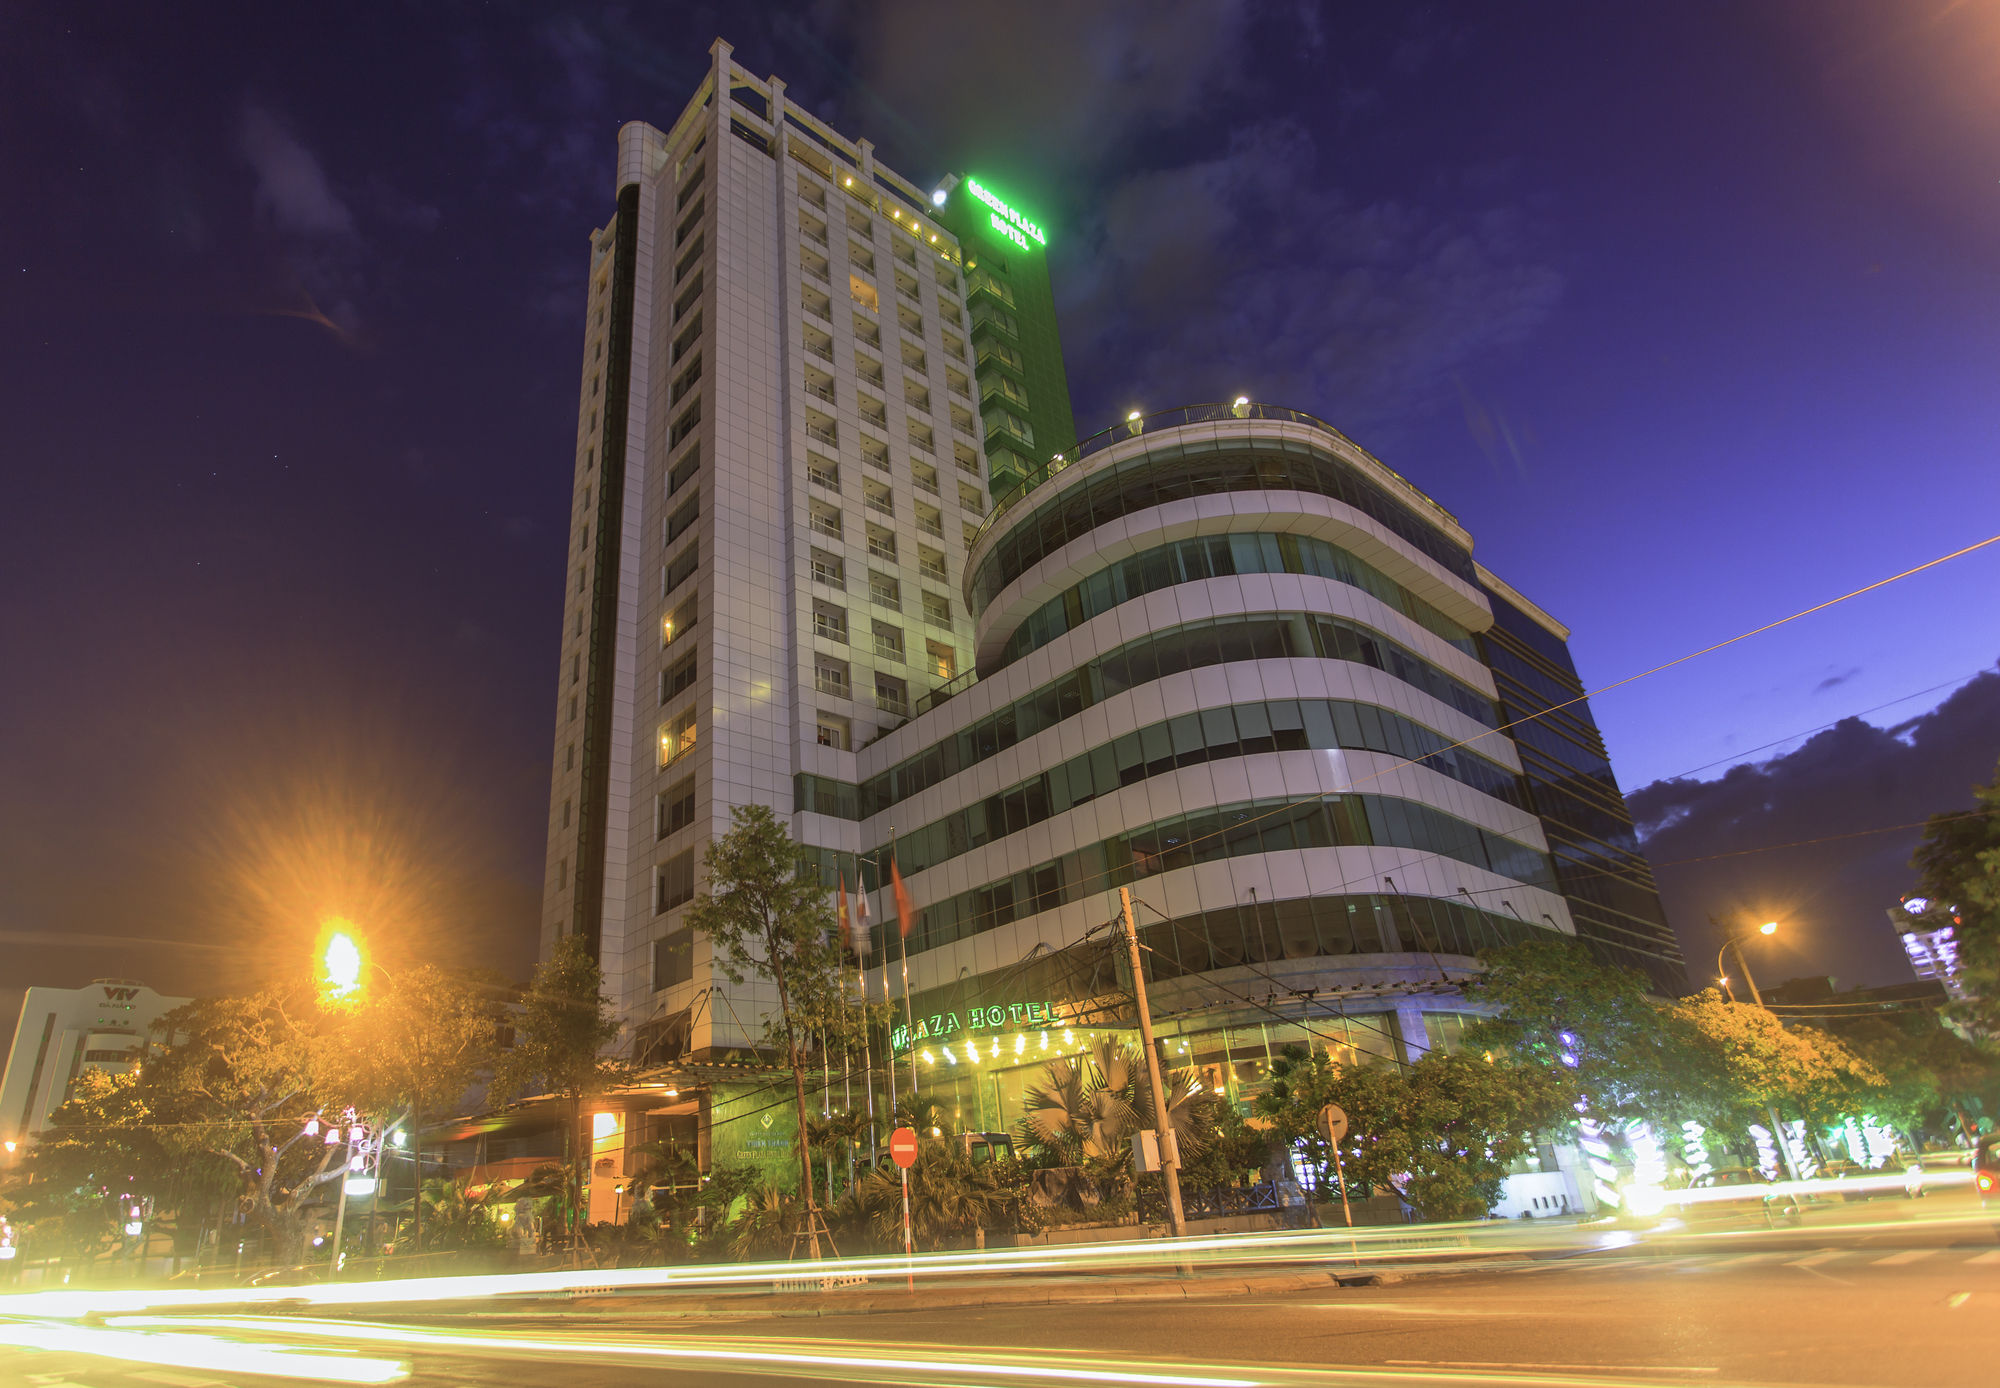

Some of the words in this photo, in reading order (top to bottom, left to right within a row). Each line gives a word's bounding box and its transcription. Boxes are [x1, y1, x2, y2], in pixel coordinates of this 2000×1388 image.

[990, 212, 1029, 251] HOTEL
[1009, 207, 1046, 246] PLAZA
[103, 986, 139, 1001] VTV
[967, 1002, 1060, 1029] HOTEL
